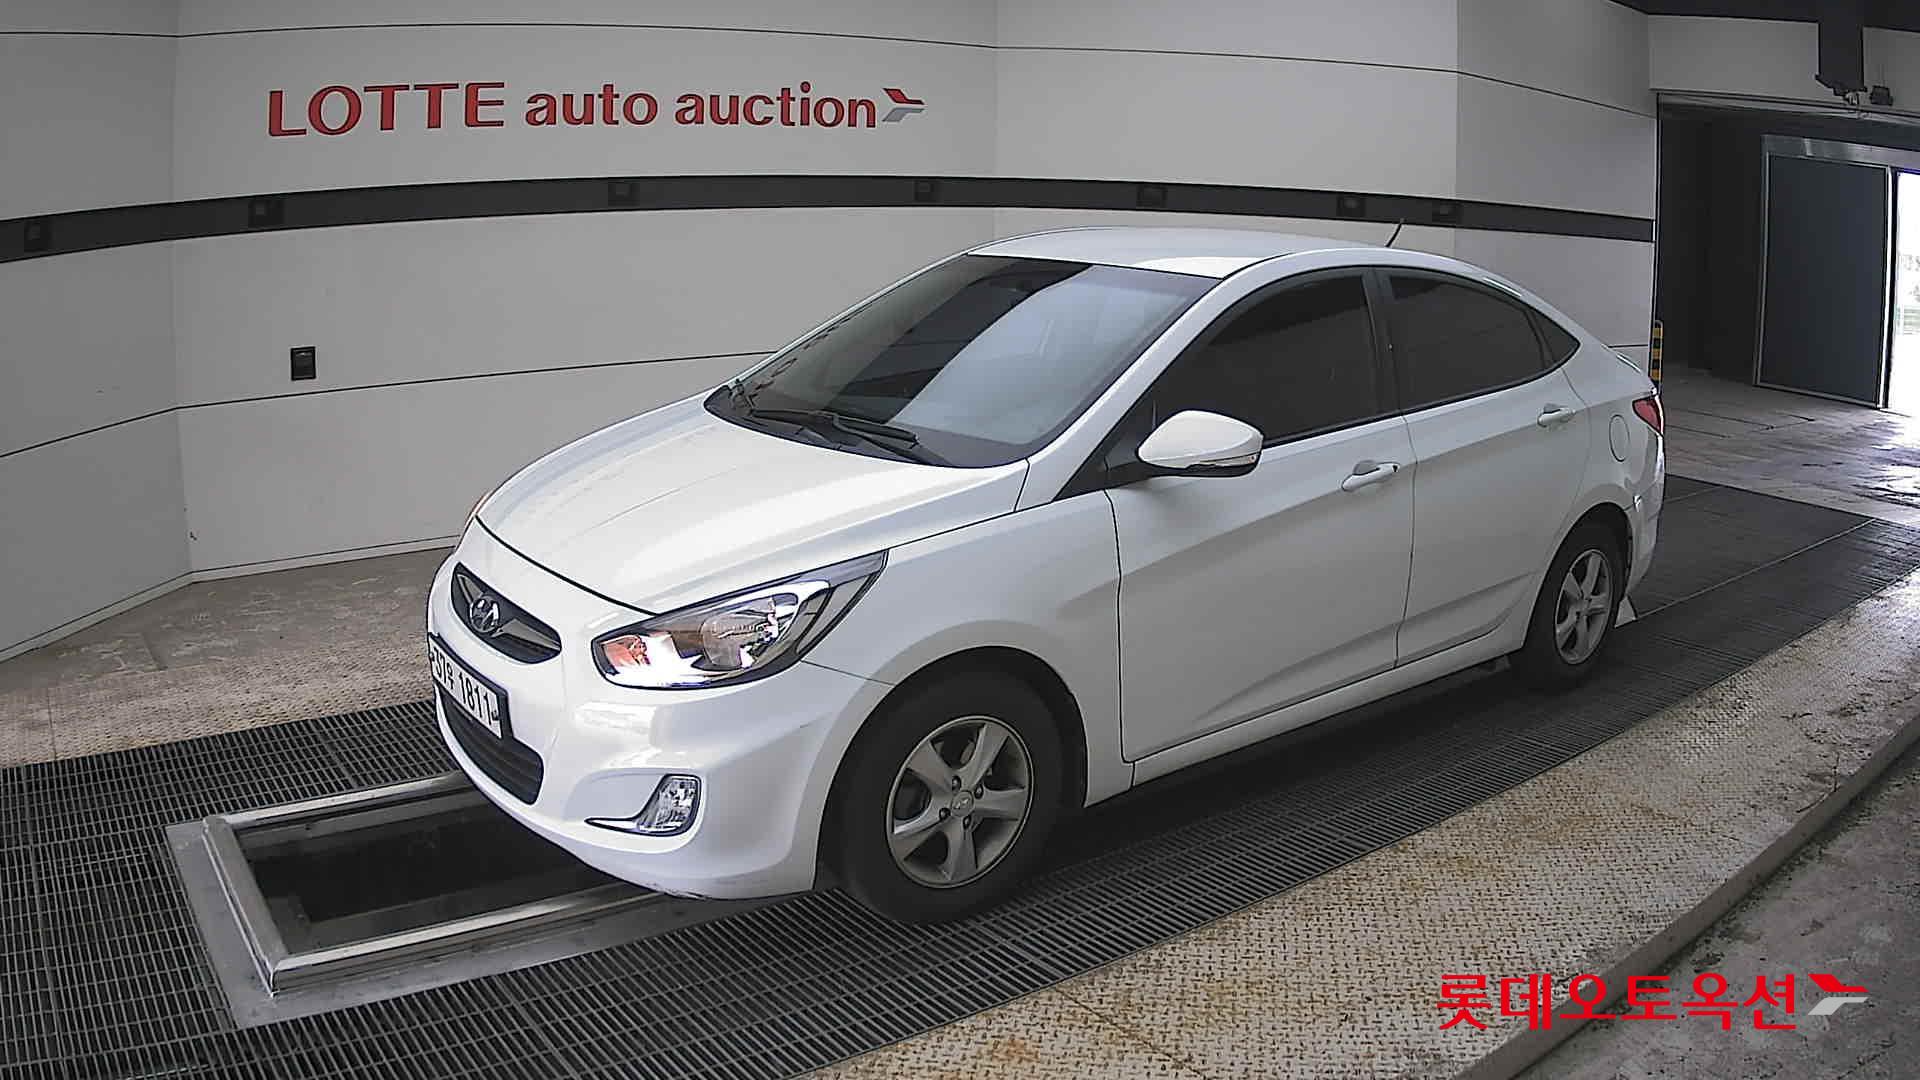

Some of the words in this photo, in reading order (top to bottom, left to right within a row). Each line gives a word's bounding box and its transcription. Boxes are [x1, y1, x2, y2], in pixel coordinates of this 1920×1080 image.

[268, 82, 505, 137] LOTTE
[525, 83, 658, 127] auto
[675, 82, 877, 128] auction
[459, 671, 492, 726] 1811
